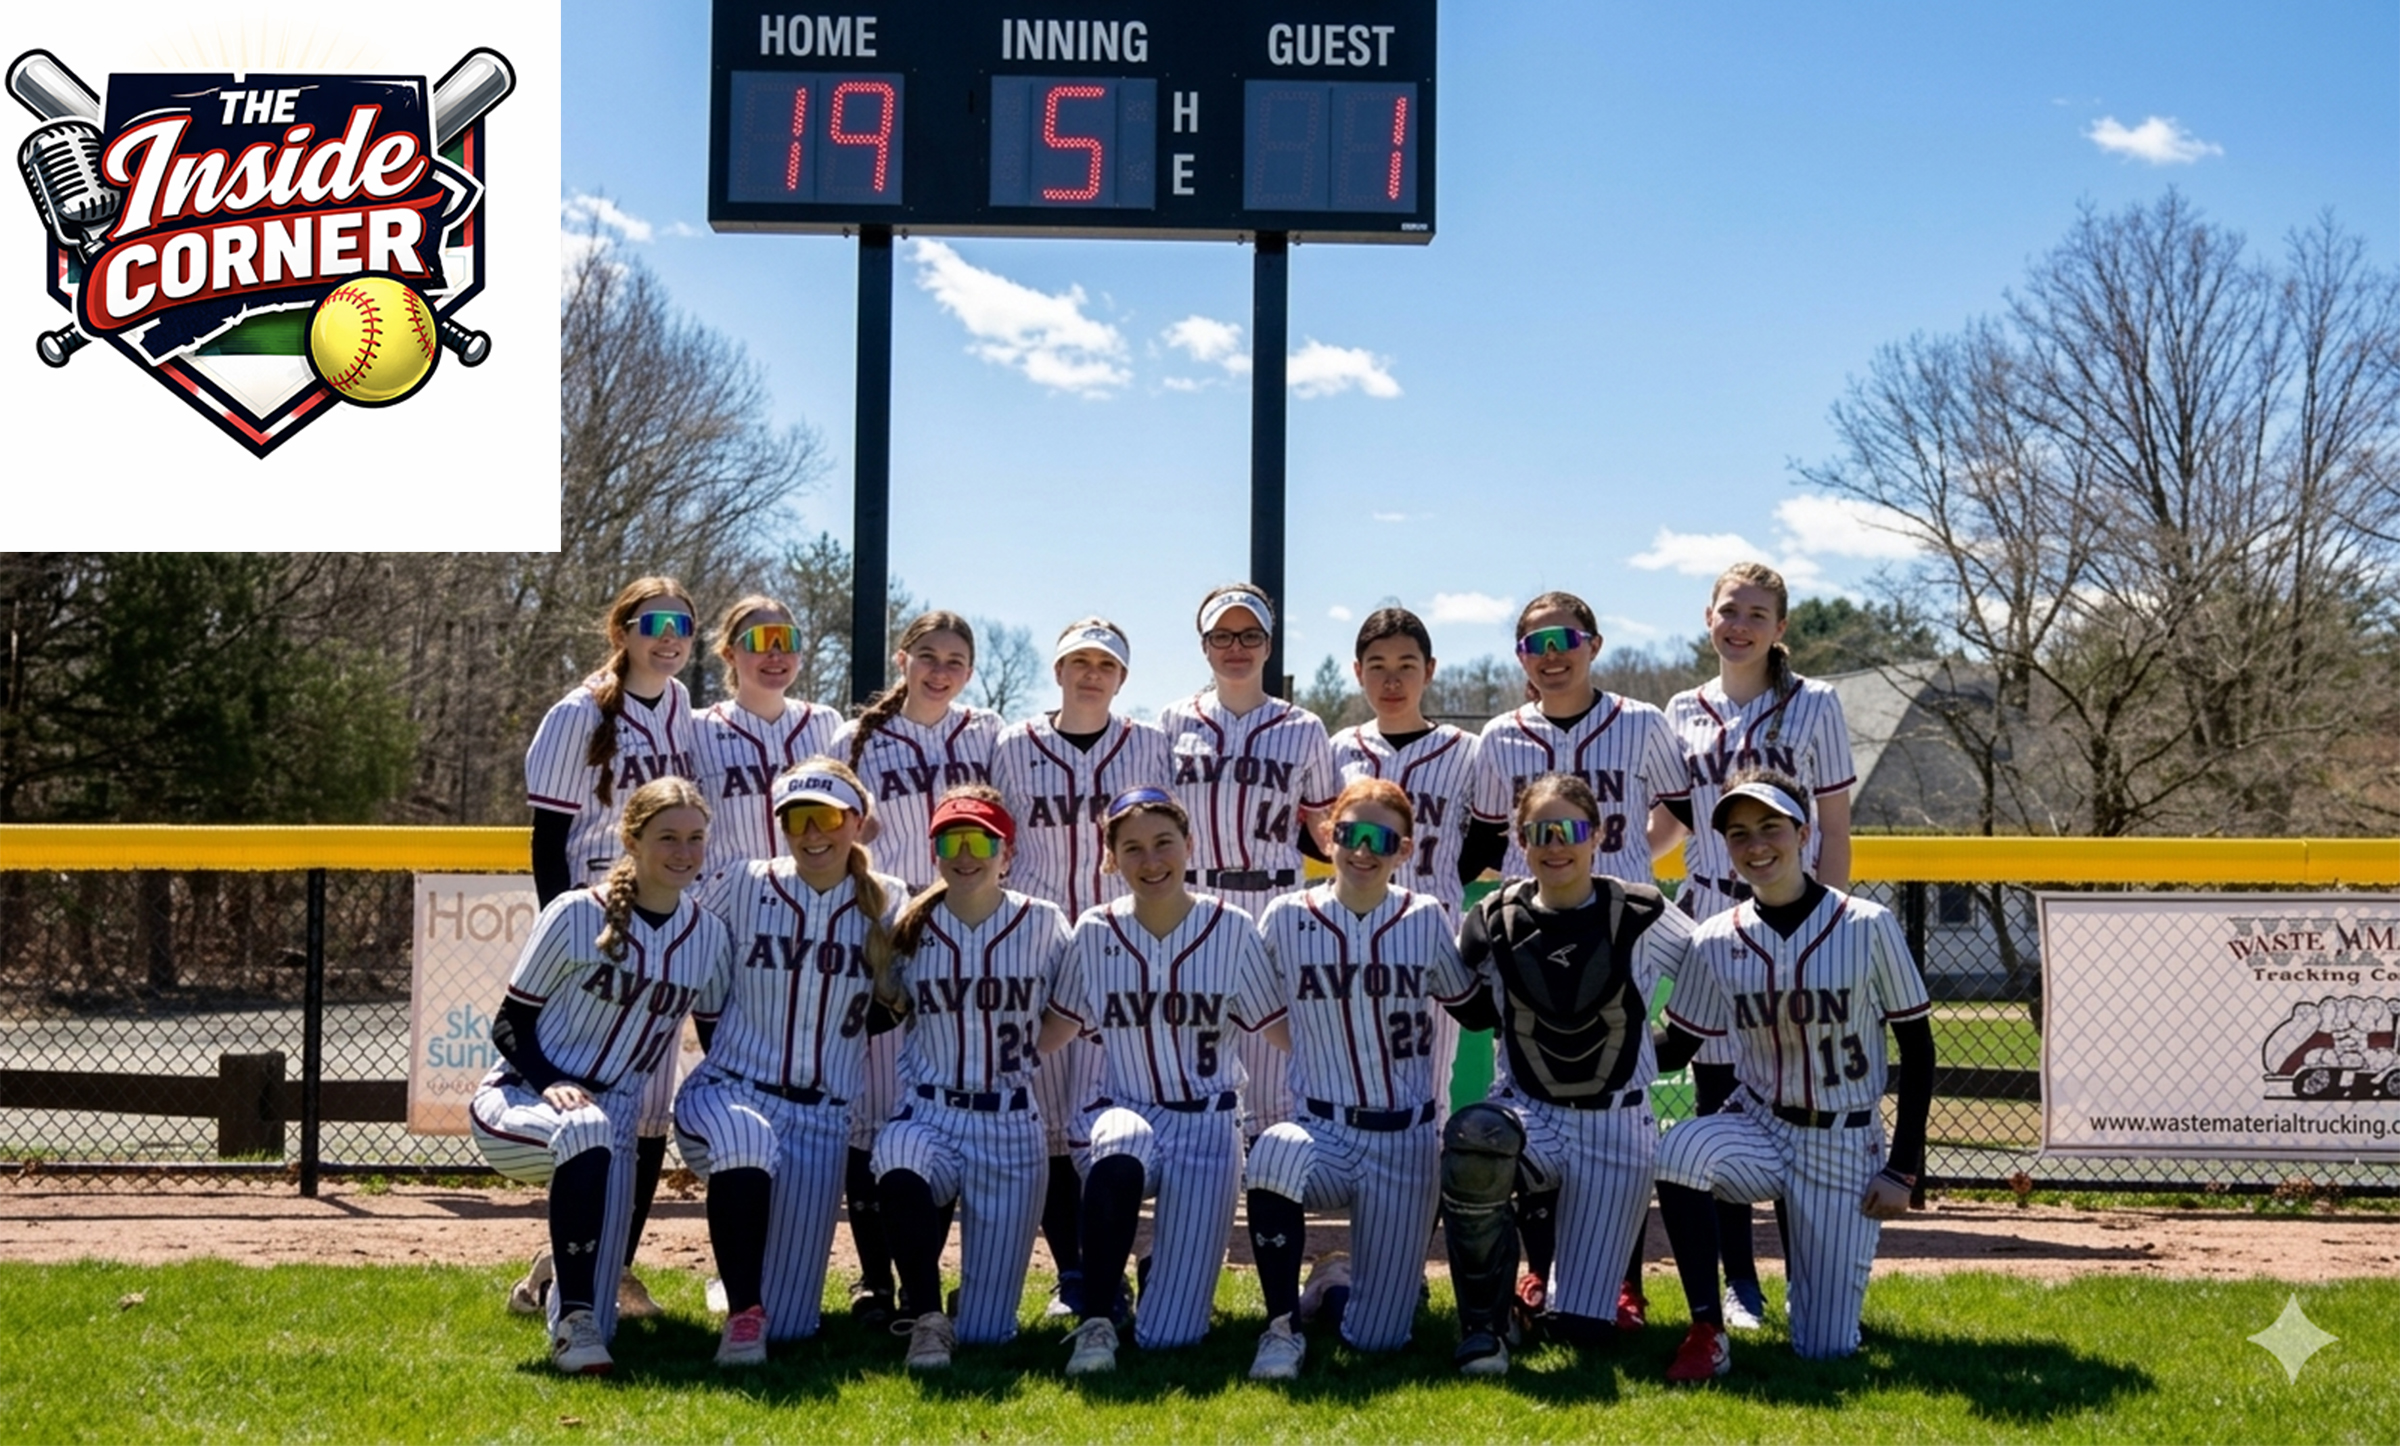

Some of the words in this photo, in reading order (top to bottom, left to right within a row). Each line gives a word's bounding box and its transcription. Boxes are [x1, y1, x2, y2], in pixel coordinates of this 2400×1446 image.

[760, 15, 877, 57] HOME
[1002, 19, 1148, 62] INNING
[1268, 24, 1395, 66] GUEST
[1173, 92, 1199, 133] H
[786, 82, 895, 192] 19
[1043, 86, 1104, 200] 5
[1389, 97, 1408, 200] 1
[1172, 154, 1195, 195] E
[1176, 755, 1294, 793] AVON
[1254, 801, 1291, 843] 14
[745, 933, 875, 979] AVON
[2227, 932, 2325, 960] WASTE
[916, 975, 1034, 1015] AVON
[1297, 963, 1425, 999] AVON
[2371, 968, 2400, 981] Co
[840, 992, 870, 1039] 8
[1103, 991, 1224, 1028] AVON
[1733, 988, 1851, 1029] AVON
[1197, 1031, 1221, 1078] 5
[1388, 1011, 1434, 1060] 22
[1818, 1032, 1869, 1087] 13
